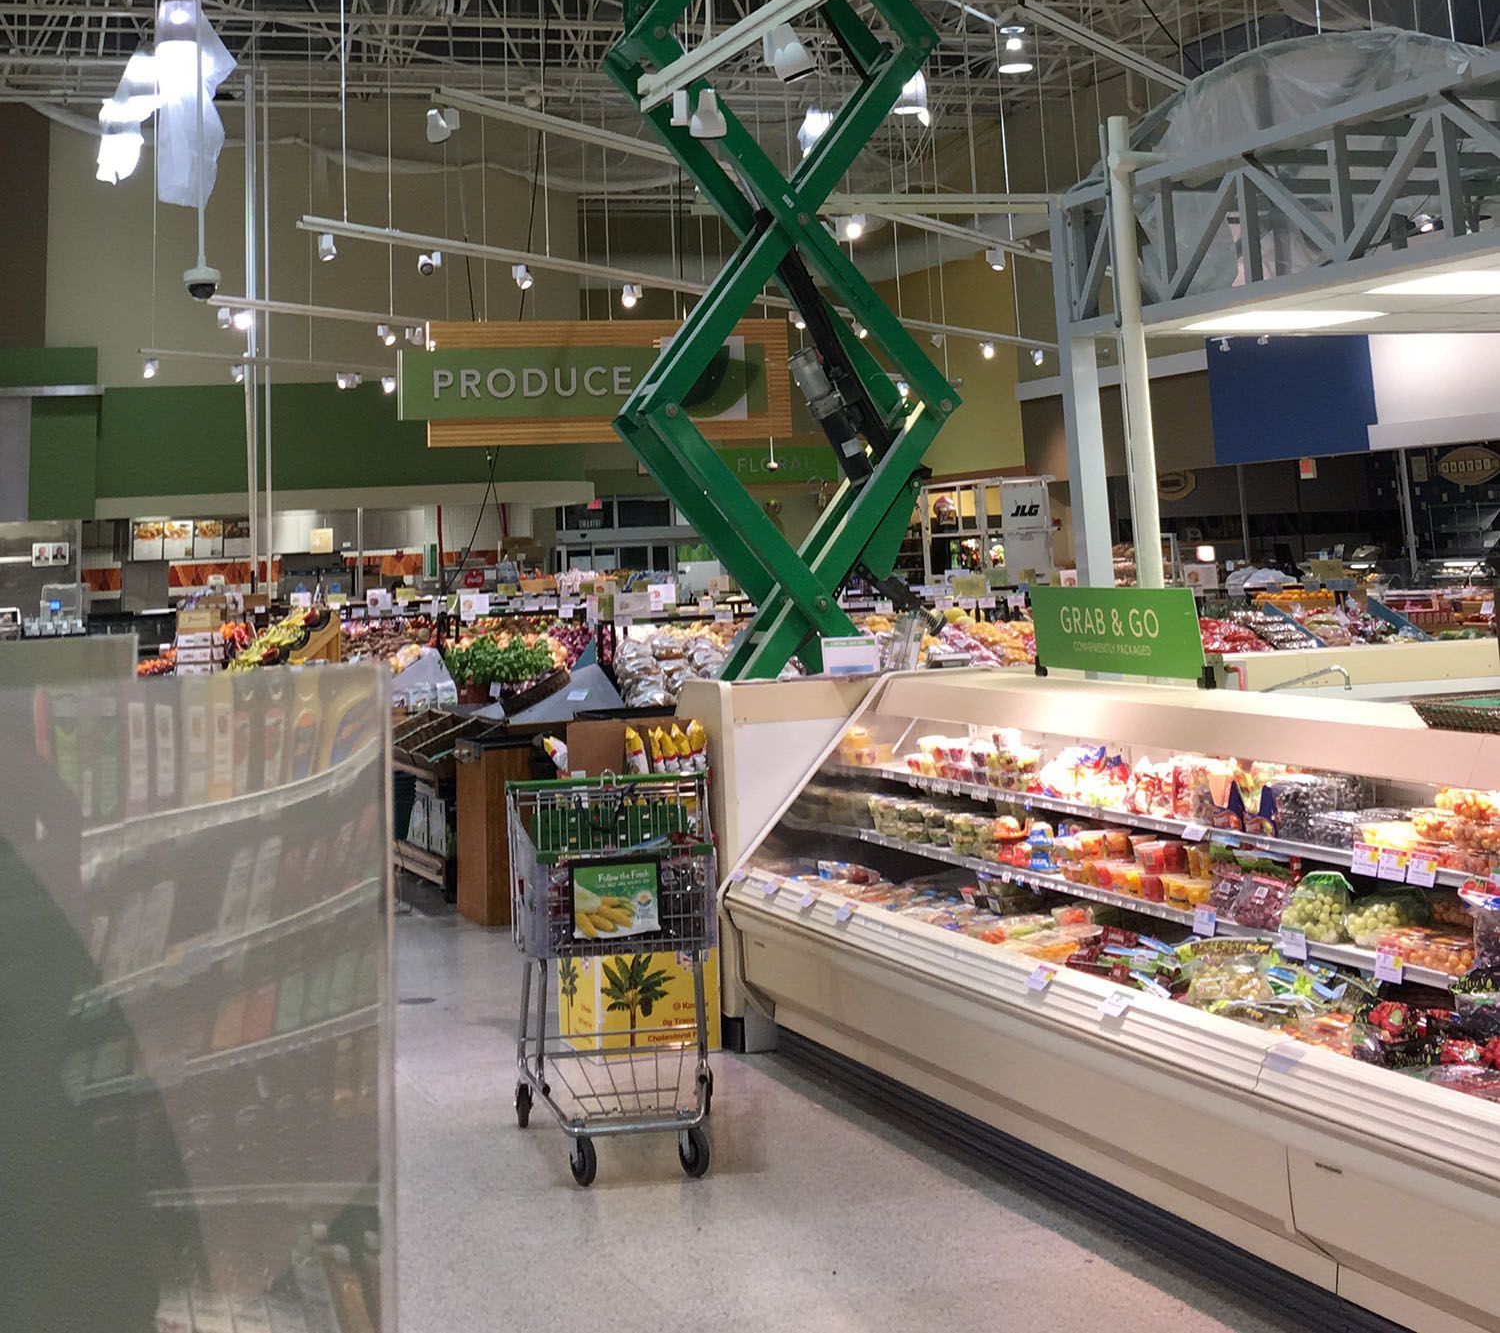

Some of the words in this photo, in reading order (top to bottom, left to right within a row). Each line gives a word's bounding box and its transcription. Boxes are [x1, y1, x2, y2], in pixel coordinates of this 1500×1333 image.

[432, 365, 633, 399] PRODUCE
[1010, 504, 1040, 517] JLG
[1060, 606, 1106, 635] GRAB
[1110, 608, 1125, 636] &
[1128, 608, 1159, 638] GO
[1116, 643, 1152, 656] PACKAGED
